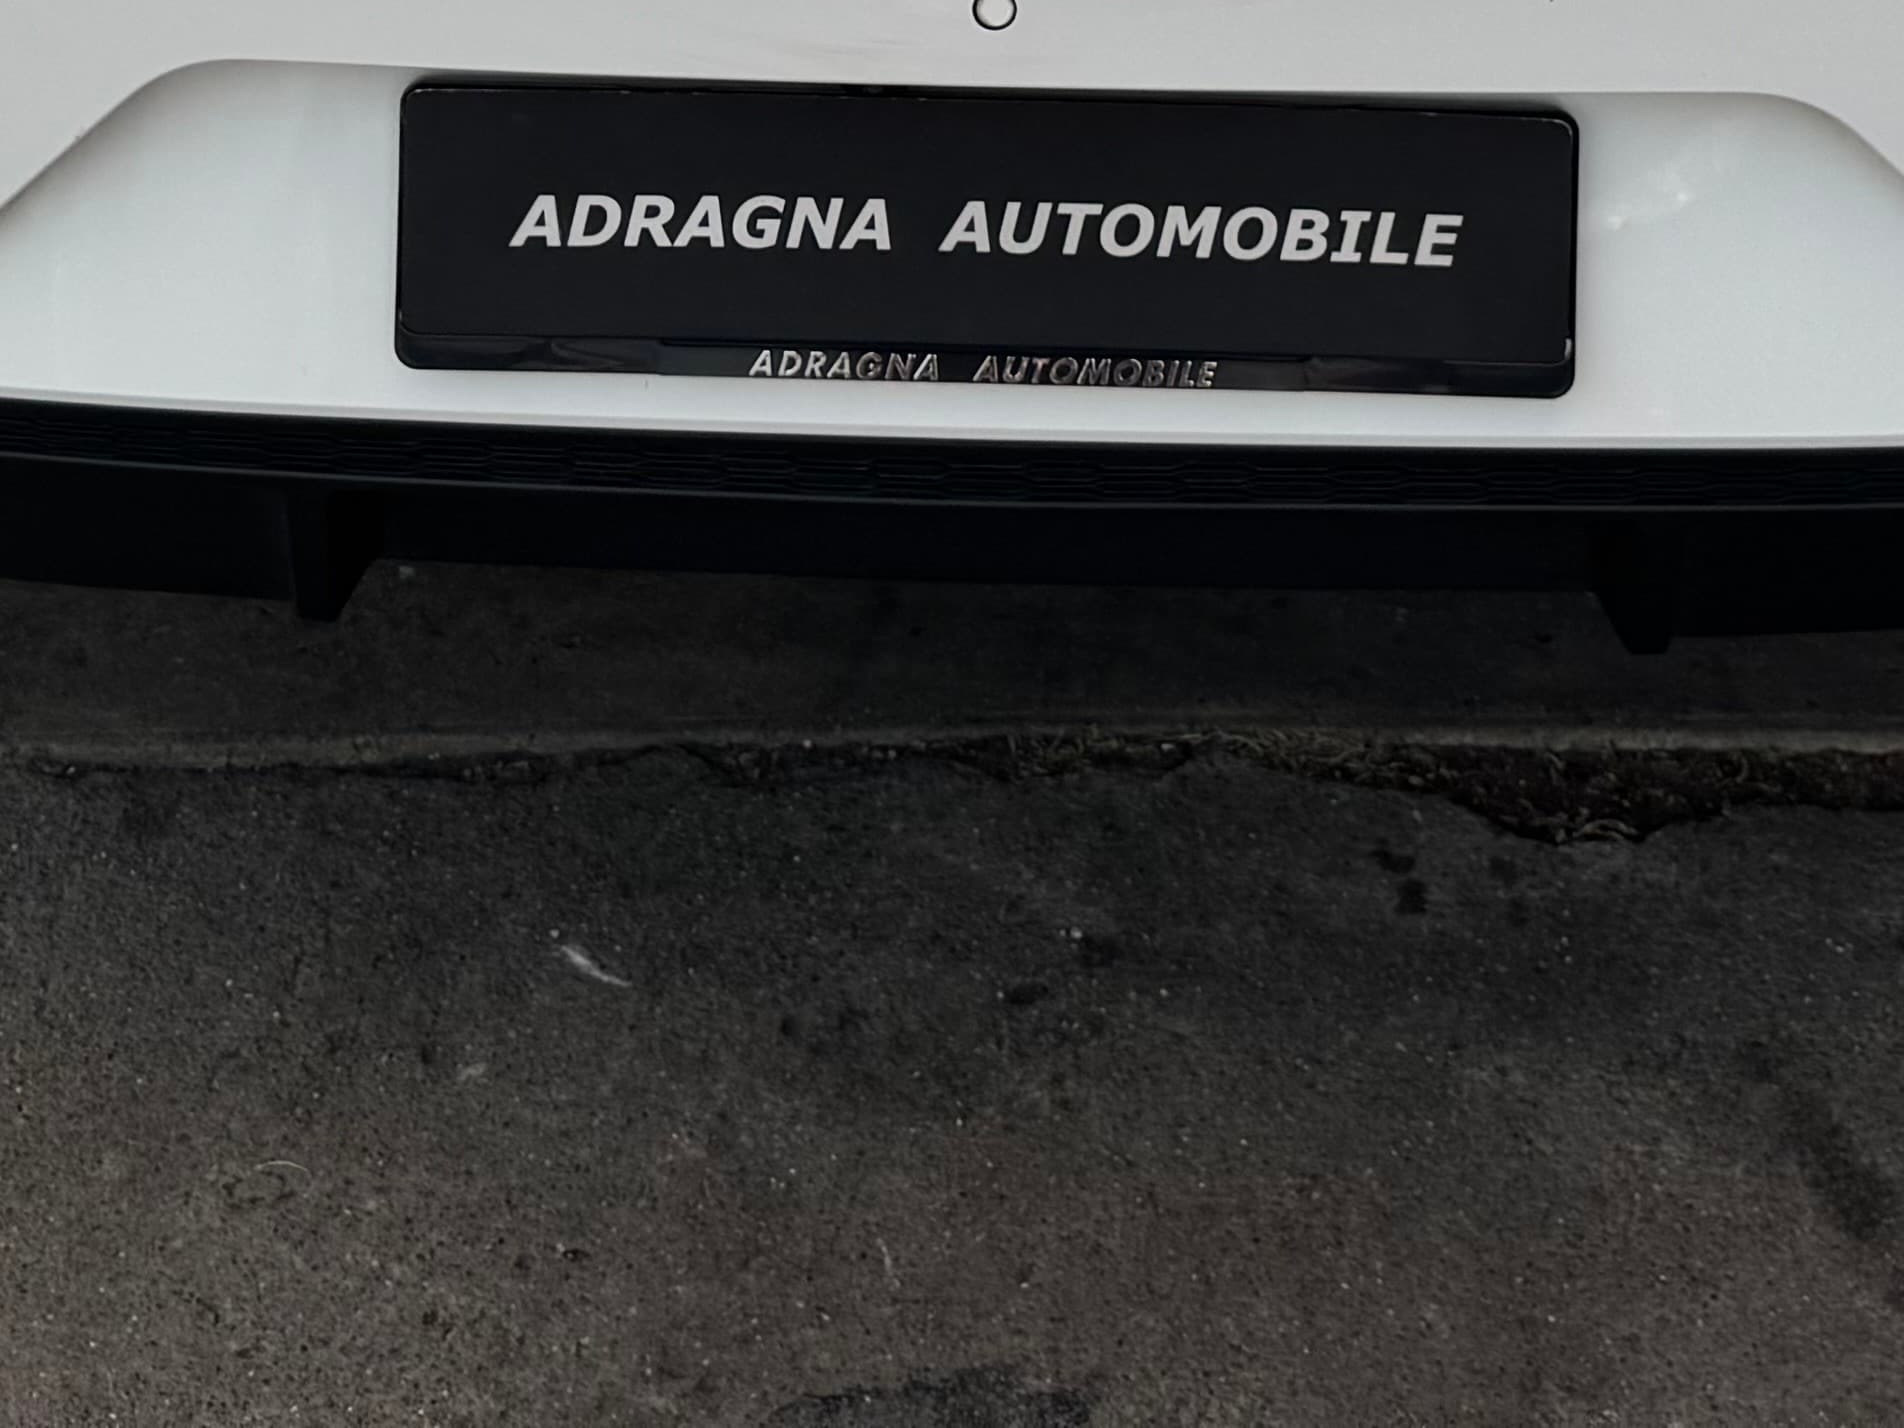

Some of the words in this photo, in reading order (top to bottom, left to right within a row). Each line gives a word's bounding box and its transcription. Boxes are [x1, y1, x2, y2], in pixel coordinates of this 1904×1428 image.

[510, 193, 895, 252] ADRAGNA
[938, 199, 1465, 267] AUTOMOBILE
[748, 349, 941, 384] ADRAGNA
[972, 353, 1219, 391] AUTOMOBILE
